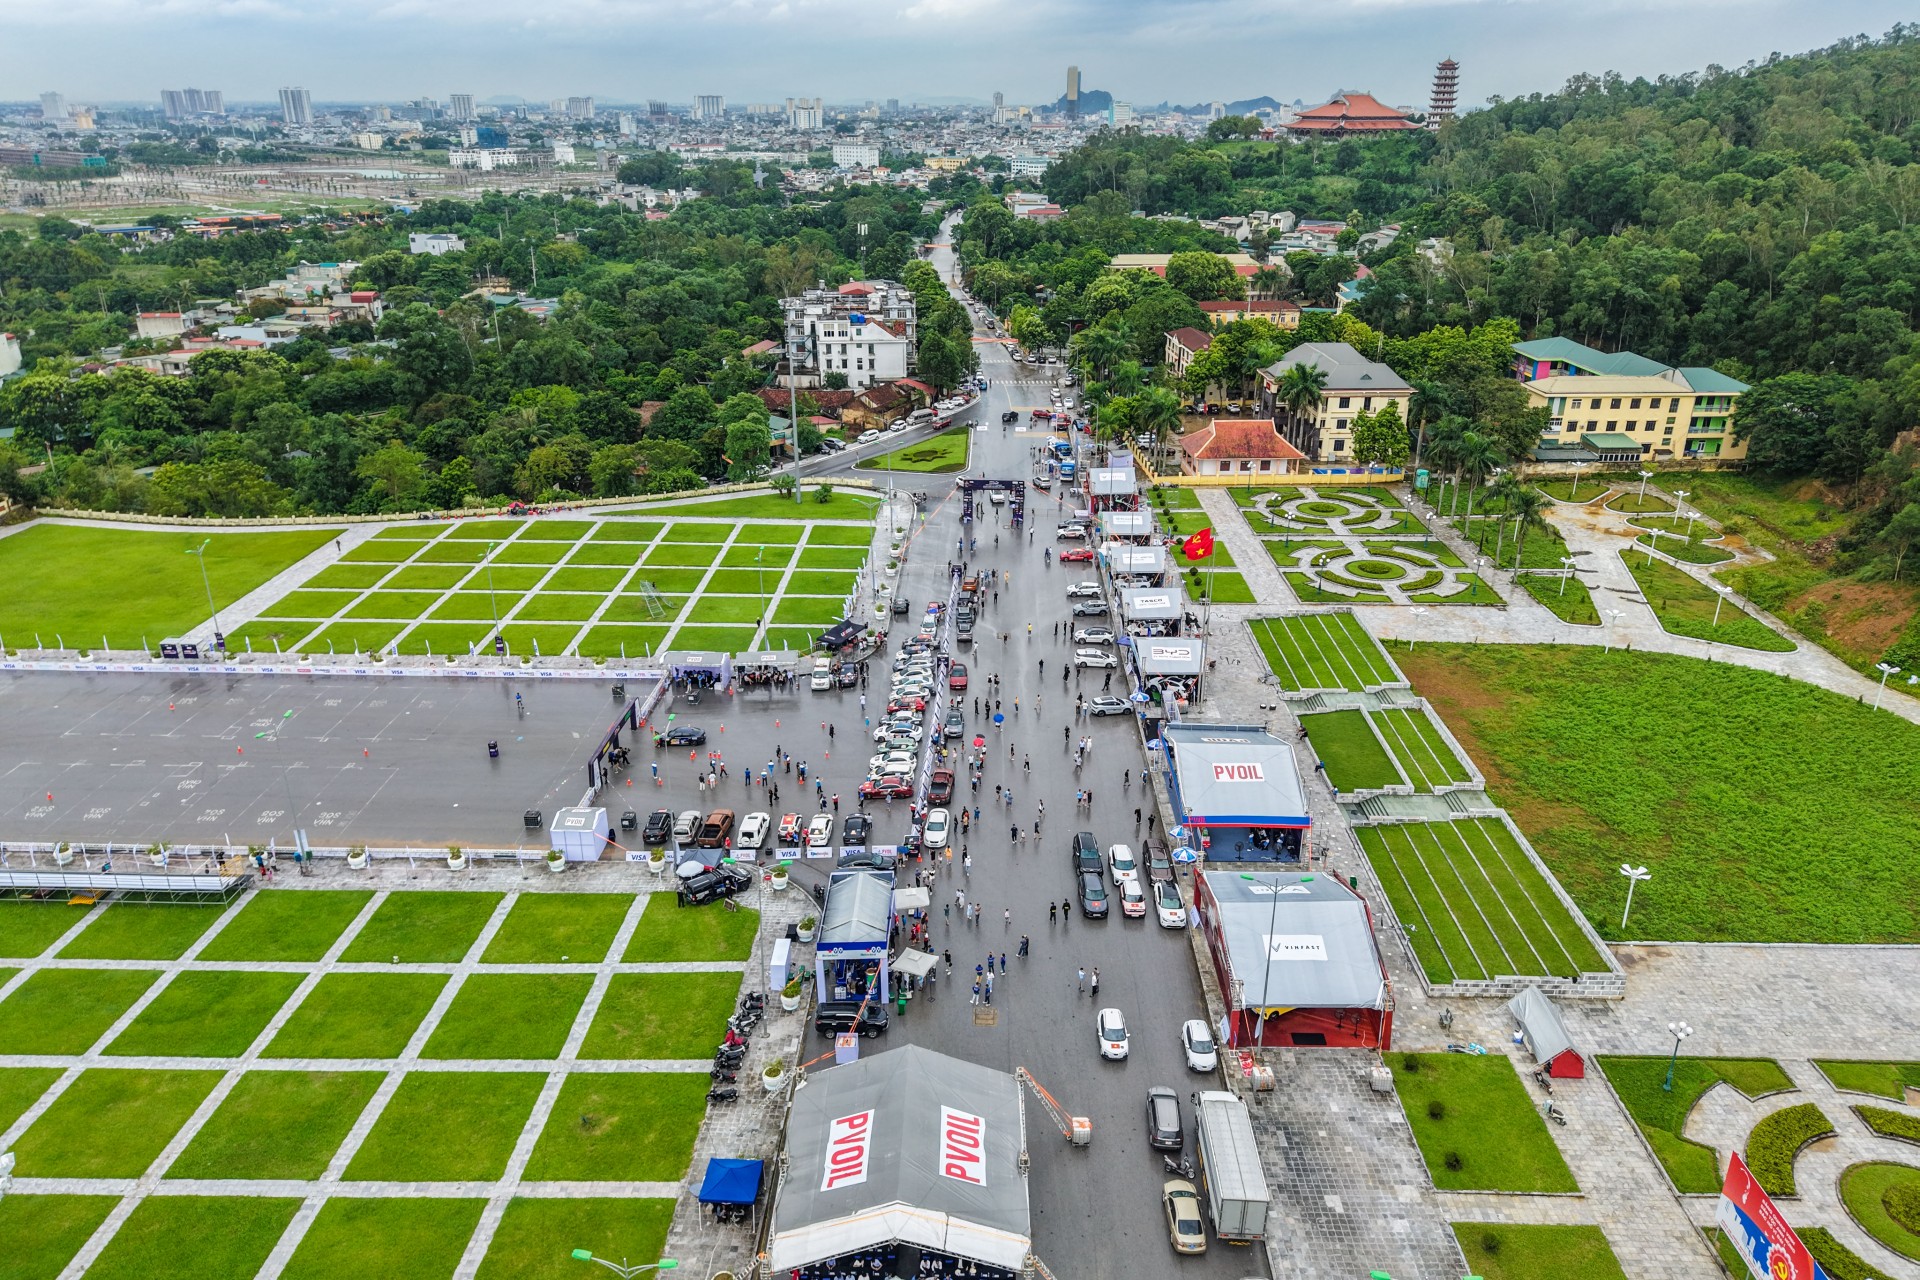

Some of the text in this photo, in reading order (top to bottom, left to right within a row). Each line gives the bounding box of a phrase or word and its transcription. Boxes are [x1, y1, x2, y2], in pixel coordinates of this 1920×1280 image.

[1214, 765, 1263, 780] PVOIL
[826, 1113, 868, 1189] PVOIL
[945, 1114, 981, 1184] PVOIL
